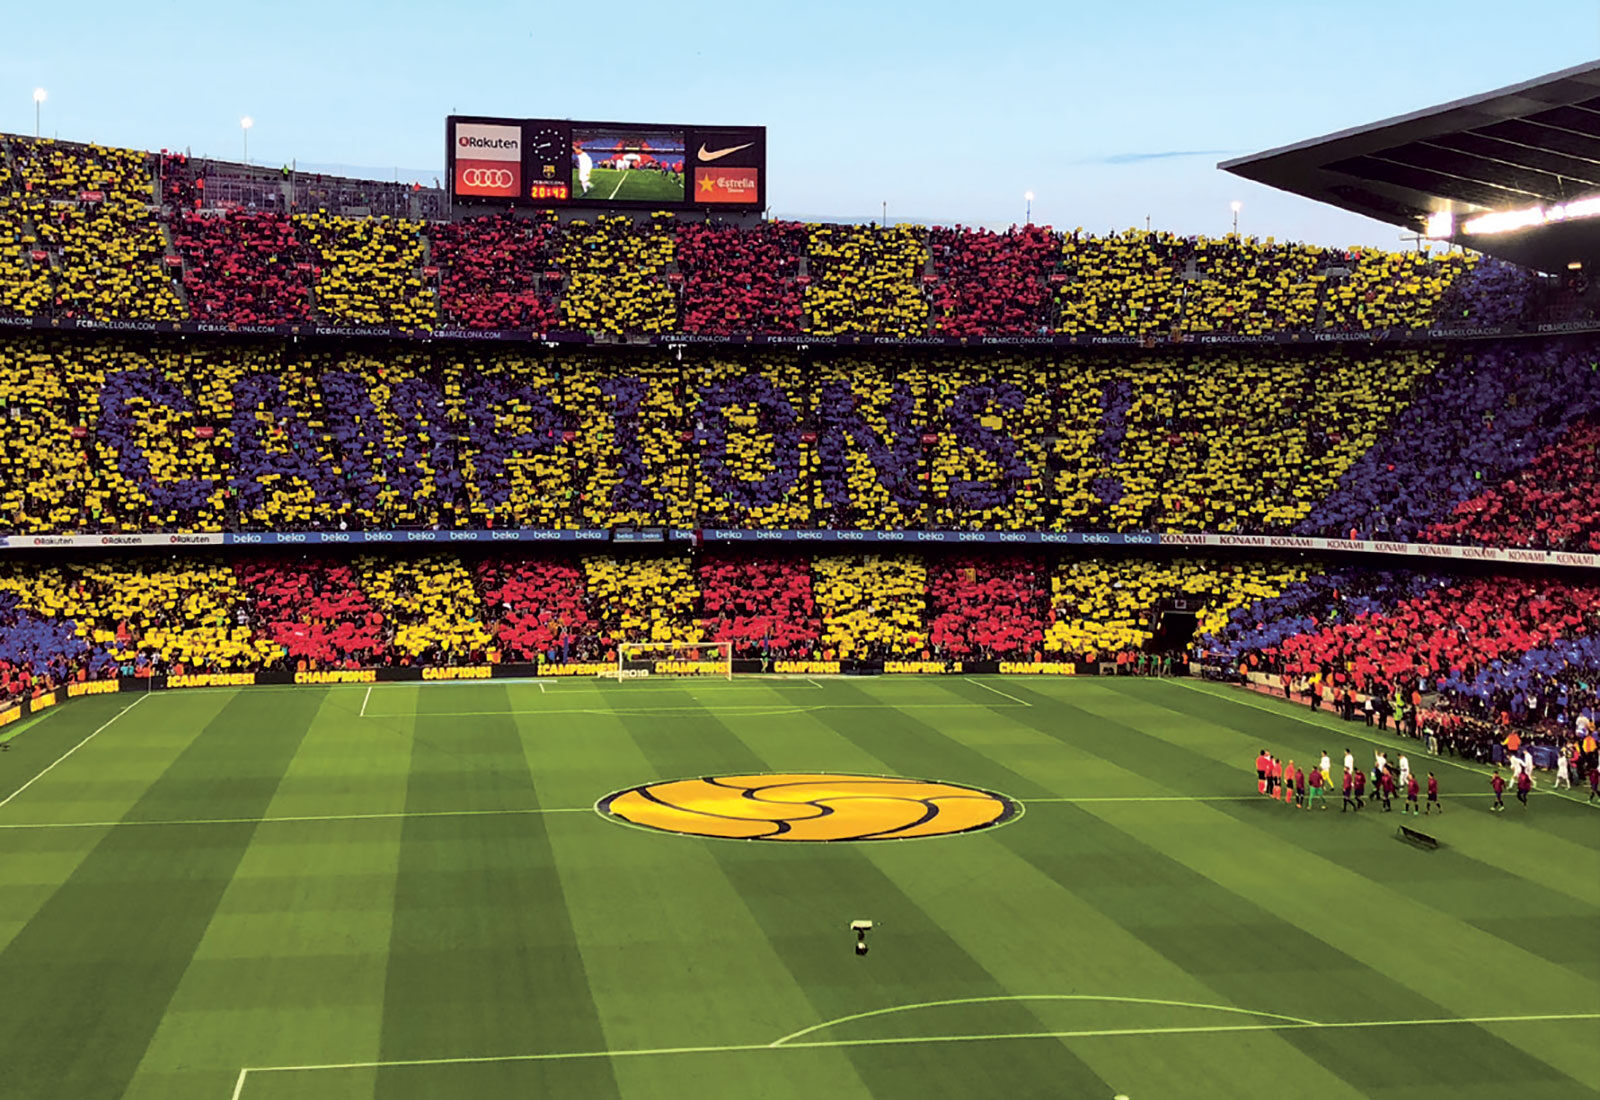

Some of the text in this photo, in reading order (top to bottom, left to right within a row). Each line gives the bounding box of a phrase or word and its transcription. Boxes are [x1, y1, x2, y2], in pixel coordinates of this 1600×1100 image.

[469, 137, 518, 149] Rakuten
[717, 177, 755, 189] Estrella
[532, 186, 567, 199] 20:42
[76, 320, 156, 331] FCBARCELONA.COM
[315, 327, 390, 336] FCBARCELONA.COM
[982, 336, 1053, 344] FCBARCELONA.COM
[1201, 335, 1275, 343] FCBARCELONA.COM
[176, 535, 210, 543] Rakuten
[233, 533, 261, 543] beko
[277, 533, 306, 542] beko
[321, 532, 350, 541] beko
[364, 532, 393, 541] beko
[407, 532, 436, 541] beko
[449, 531, 478, 540] beko
[492, 531, 519, 540] beko
[533, 531, 561, 540] beko
[575, 531, 602, 539] beko
[716, 530, 742, 539] beko
[756, 530, 782, 539] beko
[796, 530, 823, 539] beko
[837, 530, 864, 539] beko
[877, 531, 904, 540] beko
[917, 532, 944, 541] beko
[959, 533, 985, 541] beko
[999, 533, 1026, 542] beko
[1041, 533, 1067, 542] beko
[1082, 534, 1110, 543] beko
[1124, 535, 1152, 543] beko
[108, 536, 142, 544] Rakuten
[1160, 535, 1206, 544] KONAMI
[1219, 536, 1265, 546] KONAMI
[1270, 537, 1314, 547] KONAMI
[1326, 540, 1364, 550] KONAMI
[1374, 543, 1408, 553] KONAMI
[1418, 545, 1452, 556] KONAMI
[1508, 550, 1545, 563] KONAMI
[1556, 553, 1595, 566] KONAMI
[774, 661, 841, 673] CAMPIONS!
[999, 662, 1076, 675] CHAMPIONS!
[294, 670, 377, 684] CHAMPIONS!
[422, 666, 492, 680] CAMPIONS!
